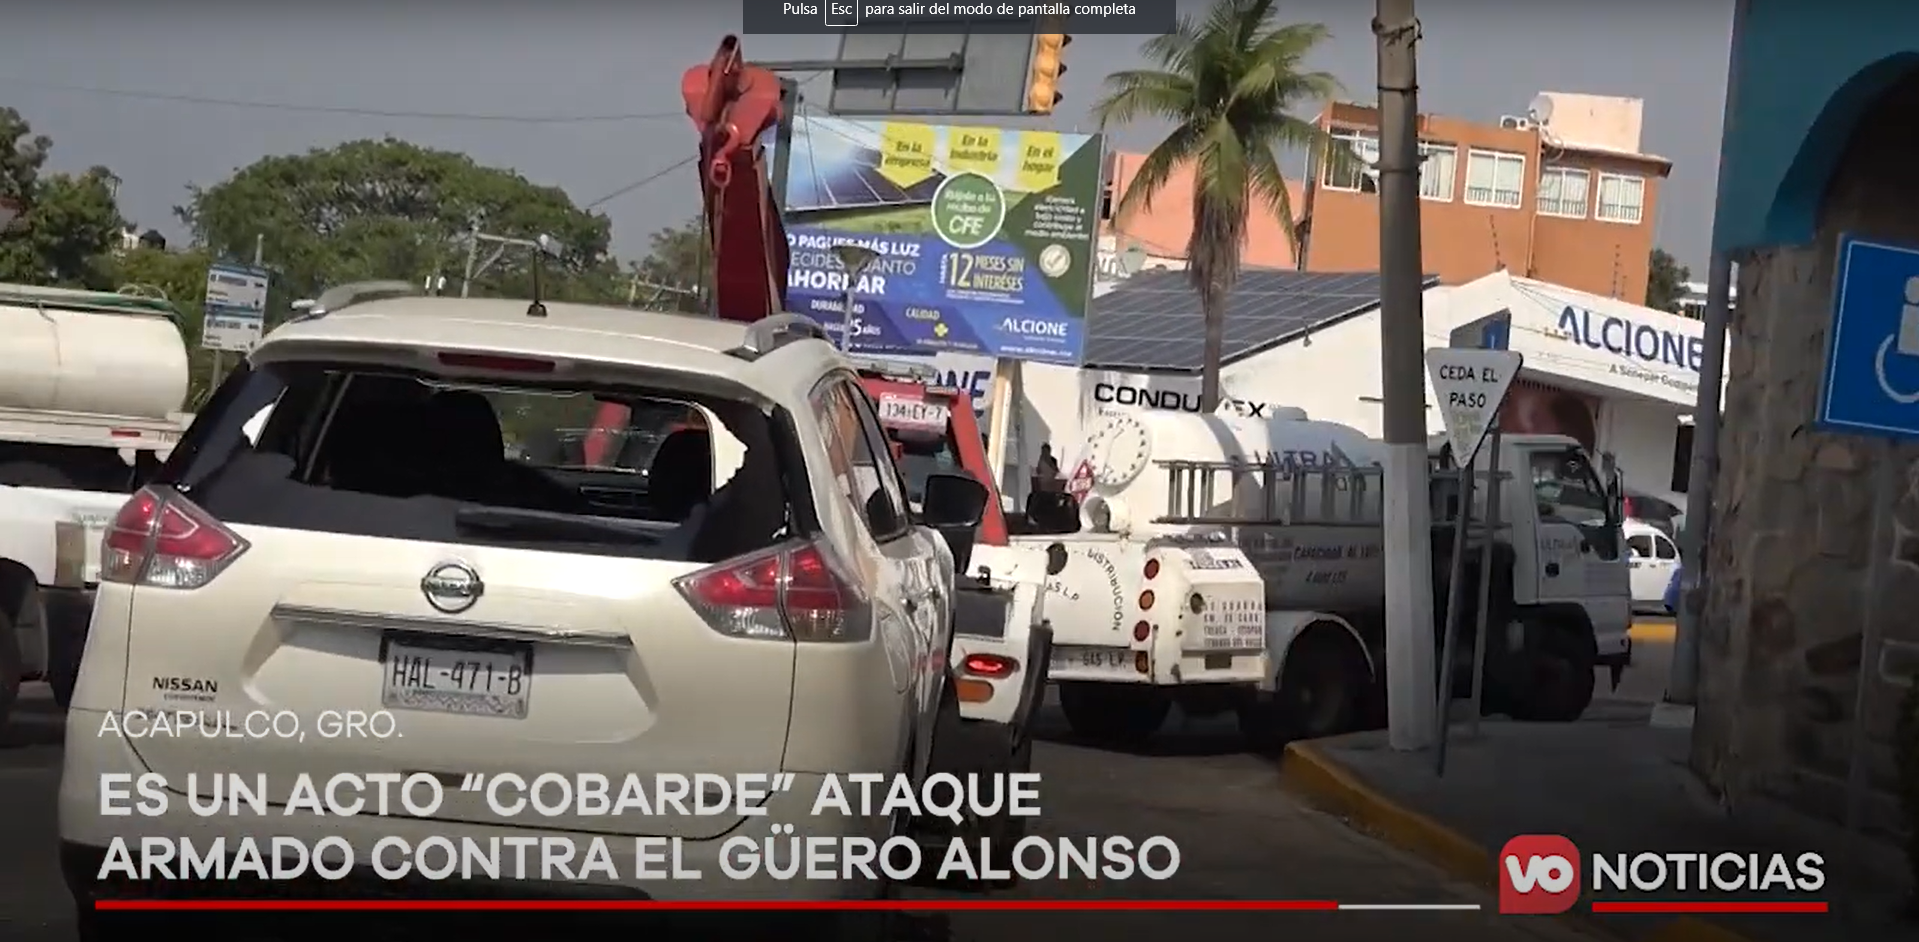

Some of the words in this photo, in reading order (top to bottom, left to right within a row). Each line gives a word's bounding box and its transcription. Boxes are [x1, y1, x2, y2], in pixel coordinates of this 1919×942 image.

[949, 215, 985, 235] CFE
[787, 234, 797, 246] O
[891, 242, 921, 257] LUZ
[790, 251, 845, 270] ECIDES
[950, 253, 974, 288] 12
[1001, 317, 1068, 336] ALCIONE
[1558, 305, 1703, 371] ALCIONE
[1440, 364, 1475, 381] CEDA
[1482, 366, 1499, 383] EL
[1094, 383, 1265, 417] CONDUEX
[1449, 392, 1486, 408] PASO
[153, 677, 218, 693] NISSAN
[393, 655, 522, 696] HAL-471-B
